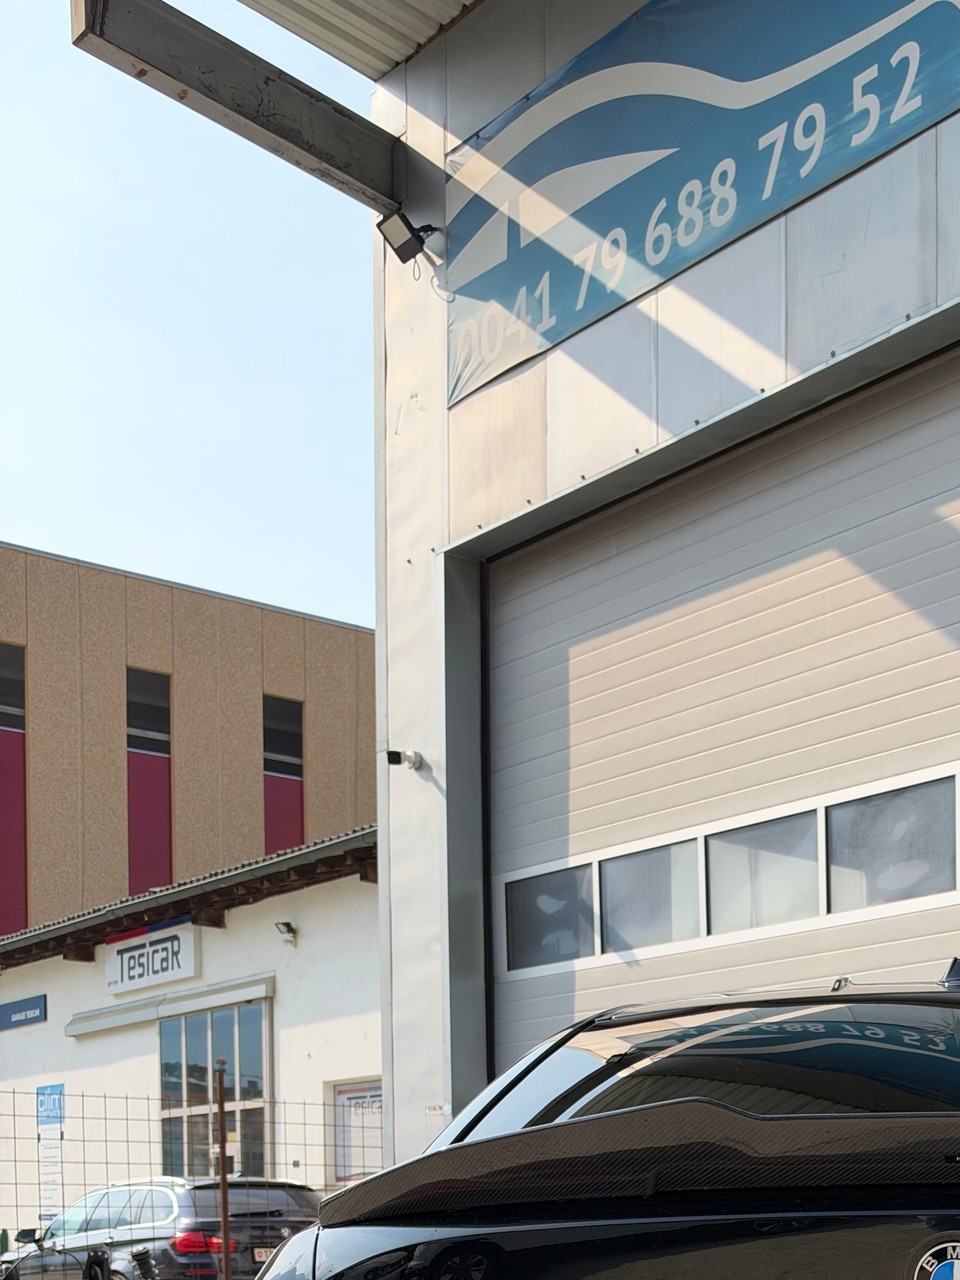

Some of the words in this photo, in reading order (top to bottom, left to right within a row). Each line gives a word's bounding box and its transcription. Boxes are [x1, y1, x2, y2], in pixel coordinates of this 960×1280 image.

[573, 227, 627, 312] 79
[645, 158, 737, 266] 688
[758, 103, 826, 200] 79
[850, 41, 922, 147] 52
